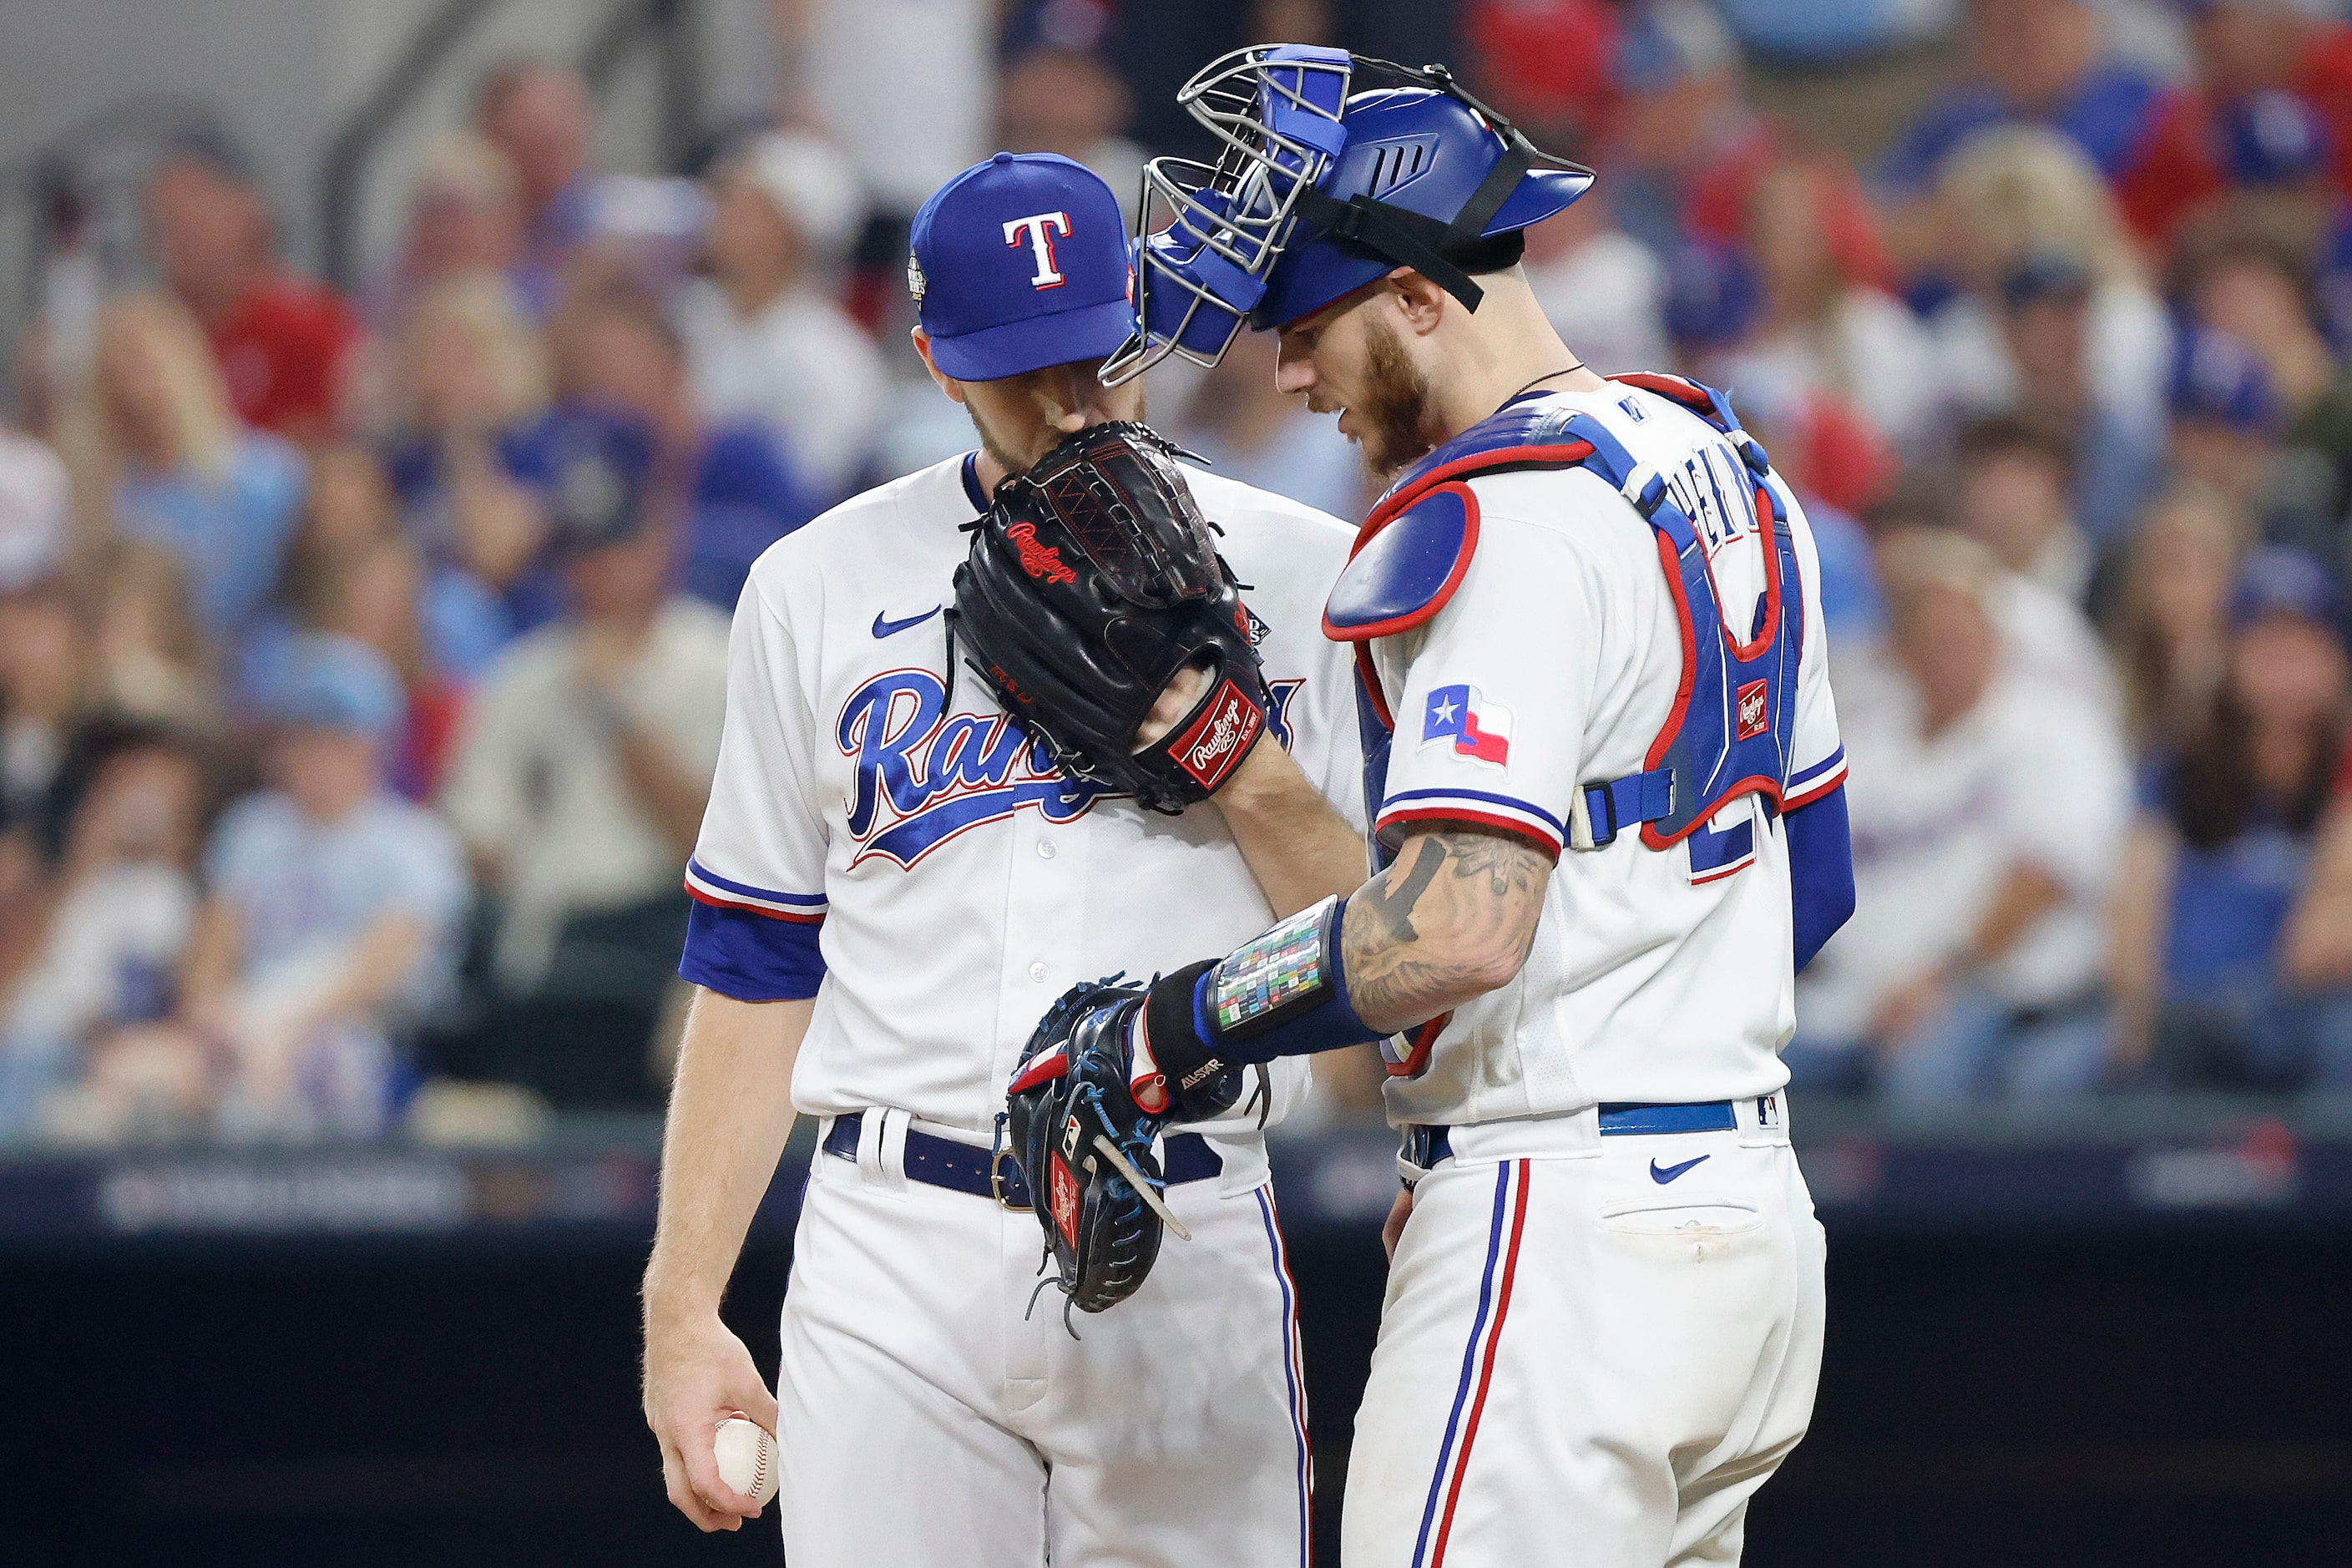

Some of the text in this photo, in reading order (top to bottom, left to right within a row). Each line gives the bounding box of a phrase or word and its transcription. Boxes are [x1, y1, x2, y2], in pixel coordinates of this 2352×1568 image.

[1001, 210, 1074, 291] T
[1006, 521, 1078, 584] Rawlings
[1192, 698, 1240, 771] Rawlings
